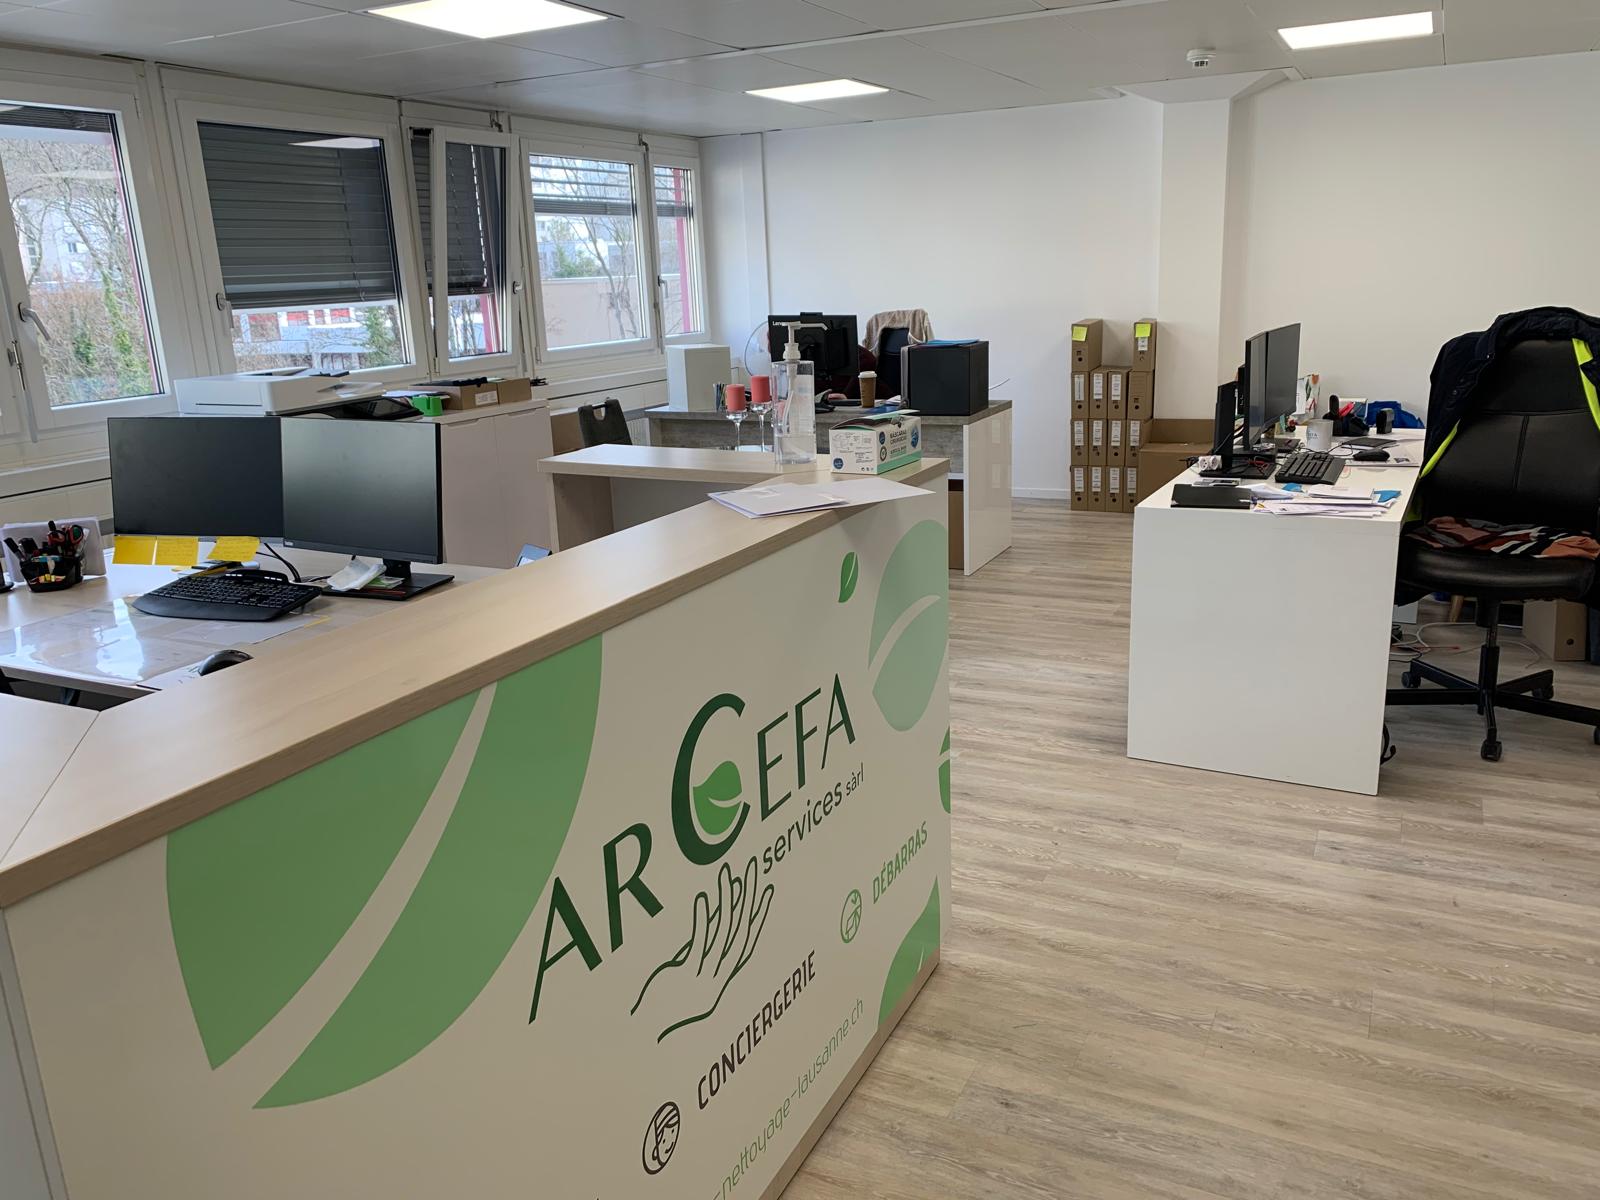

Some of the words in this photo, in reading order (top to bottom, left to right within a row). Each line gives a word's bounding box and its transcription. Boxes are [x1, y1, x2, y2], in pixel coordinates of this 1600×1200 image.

[529, 673, 856, 1025] ARCEFA
[763, 782, 842, 875] services
[846, 762, 864, 796] sàrl
[872, 820, 928, 904] DÉBARRAS
[697, 949, 816, 1110] CONCIERGERIE
